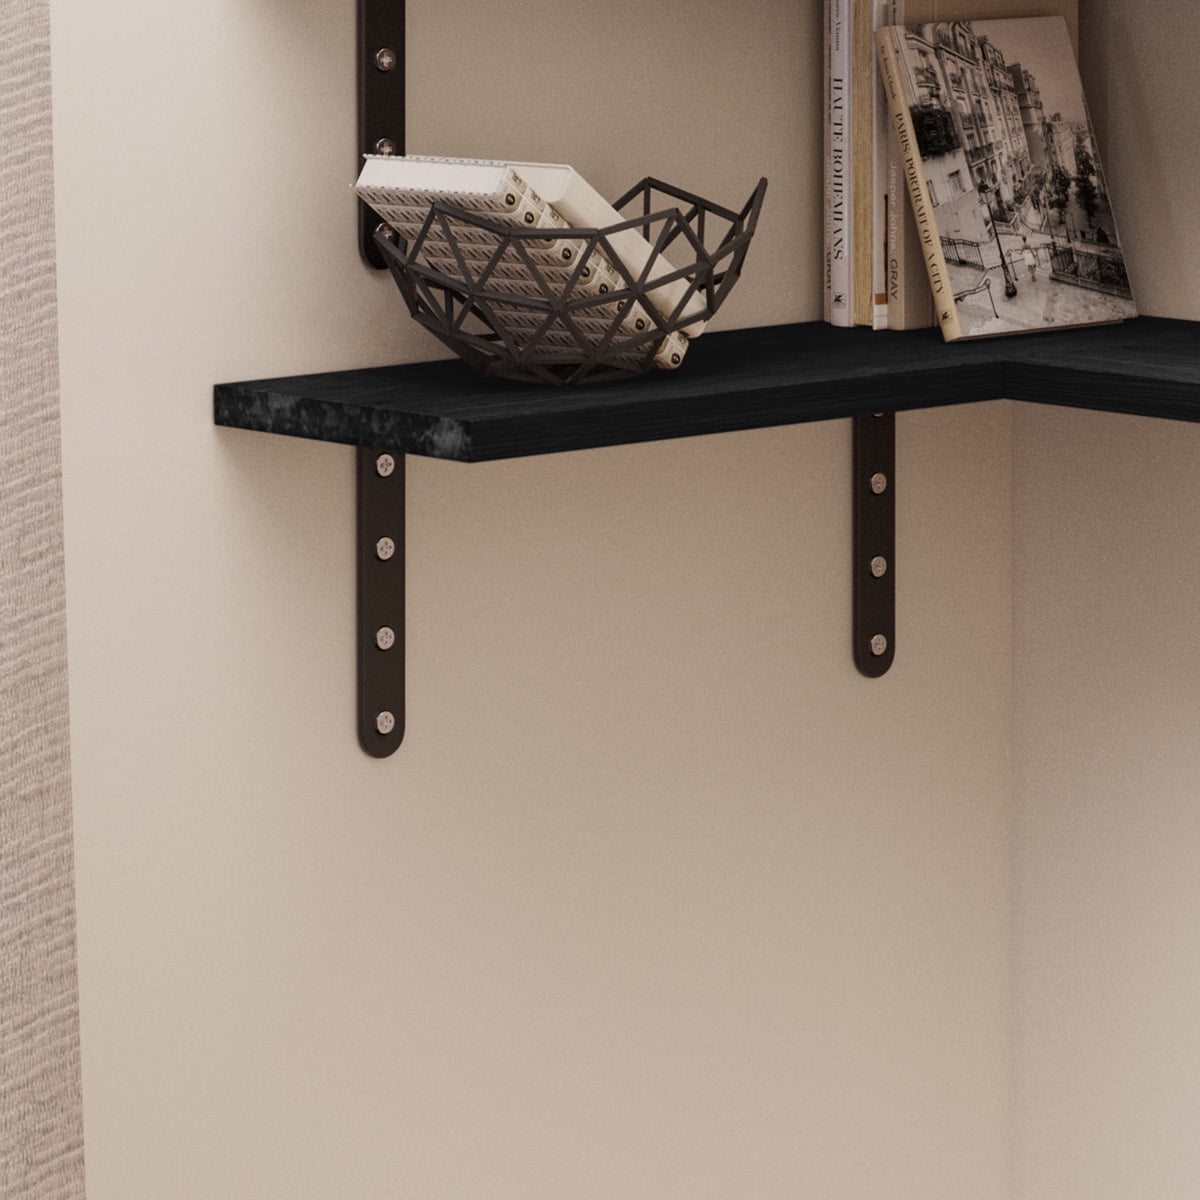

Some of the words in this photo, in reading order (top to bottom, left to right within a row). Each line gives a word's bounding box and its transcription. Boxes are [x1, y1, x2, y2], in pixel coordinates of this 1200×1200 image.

[833, 78, 843, 142] HAUTE
[833, 148, 843, 260] BOHEMIANS
[895, 113, 911, 156] PARIS:
[905, 158, 928, 226] PORTRAIT
[922, 229, 934, 247] OF
[930, 263, 945, 295] CITY
[889, 258, 898, 299] GRAY
